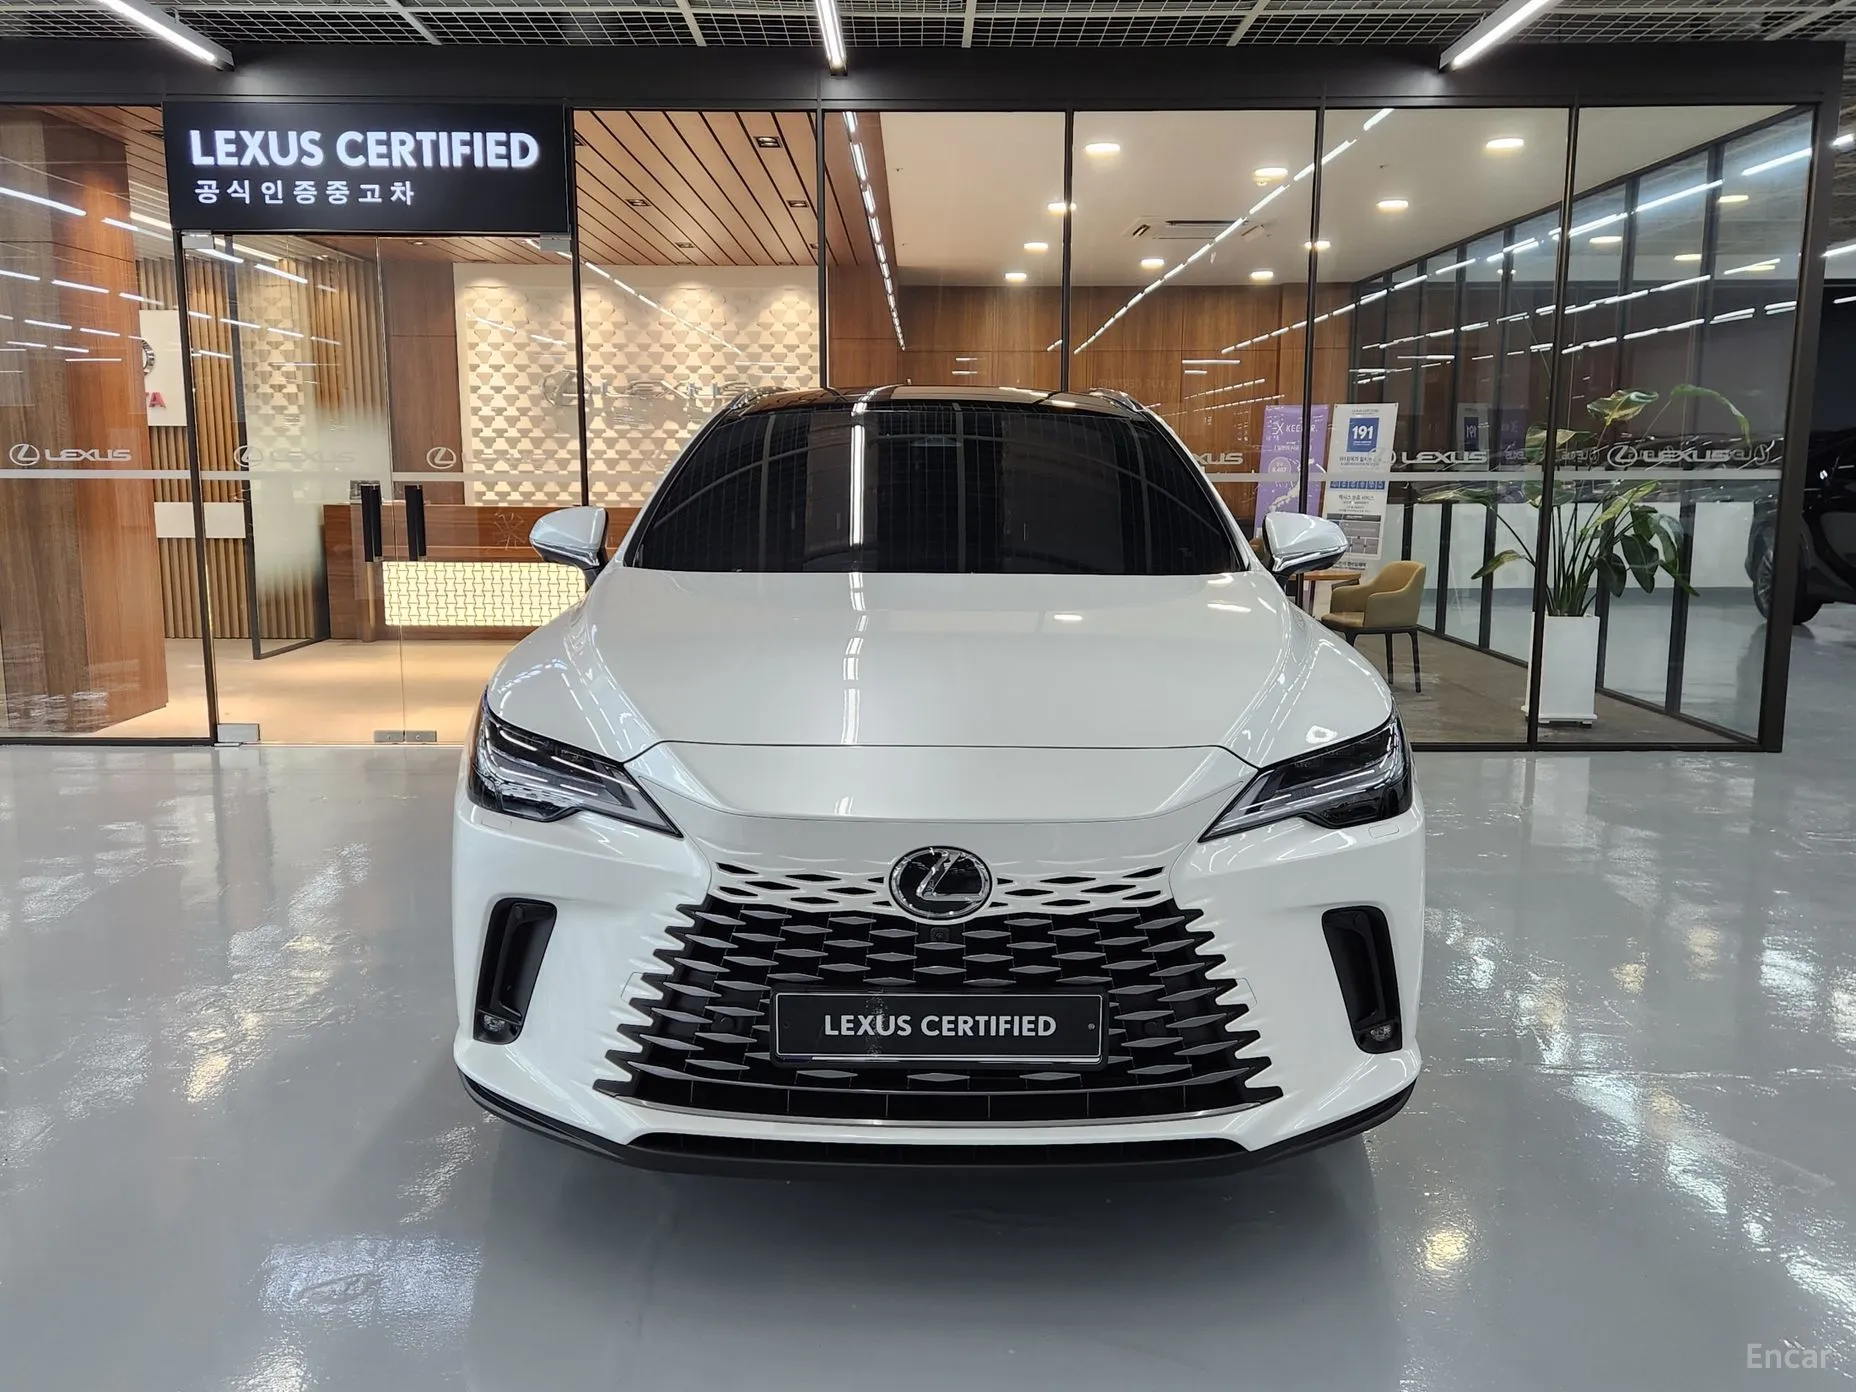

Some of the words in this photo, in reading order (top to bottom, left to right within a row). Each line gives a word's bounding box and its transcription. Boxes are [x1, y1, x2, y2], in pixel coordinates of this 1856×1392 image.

[189, 129, 324, 167] LEXUS
[336, 131, 540, 169] CERTIFIED
[194, 179, 415, 206] 공식인증중고차
[1352, 425, 1373, 440] 191
[45, 449, 132, 462] LEXUS
[271, 450, 356, 463] LEXUS
[1191, 452, 1243, 465] XUS
[1402, 451, 1487, 464] LEXUS
[1642, 449, 1732, 462] LEXUS
[824, 1014, 912, 1037] LEXUS
[920, 1015, 1057, 1037] CERTIFIED
